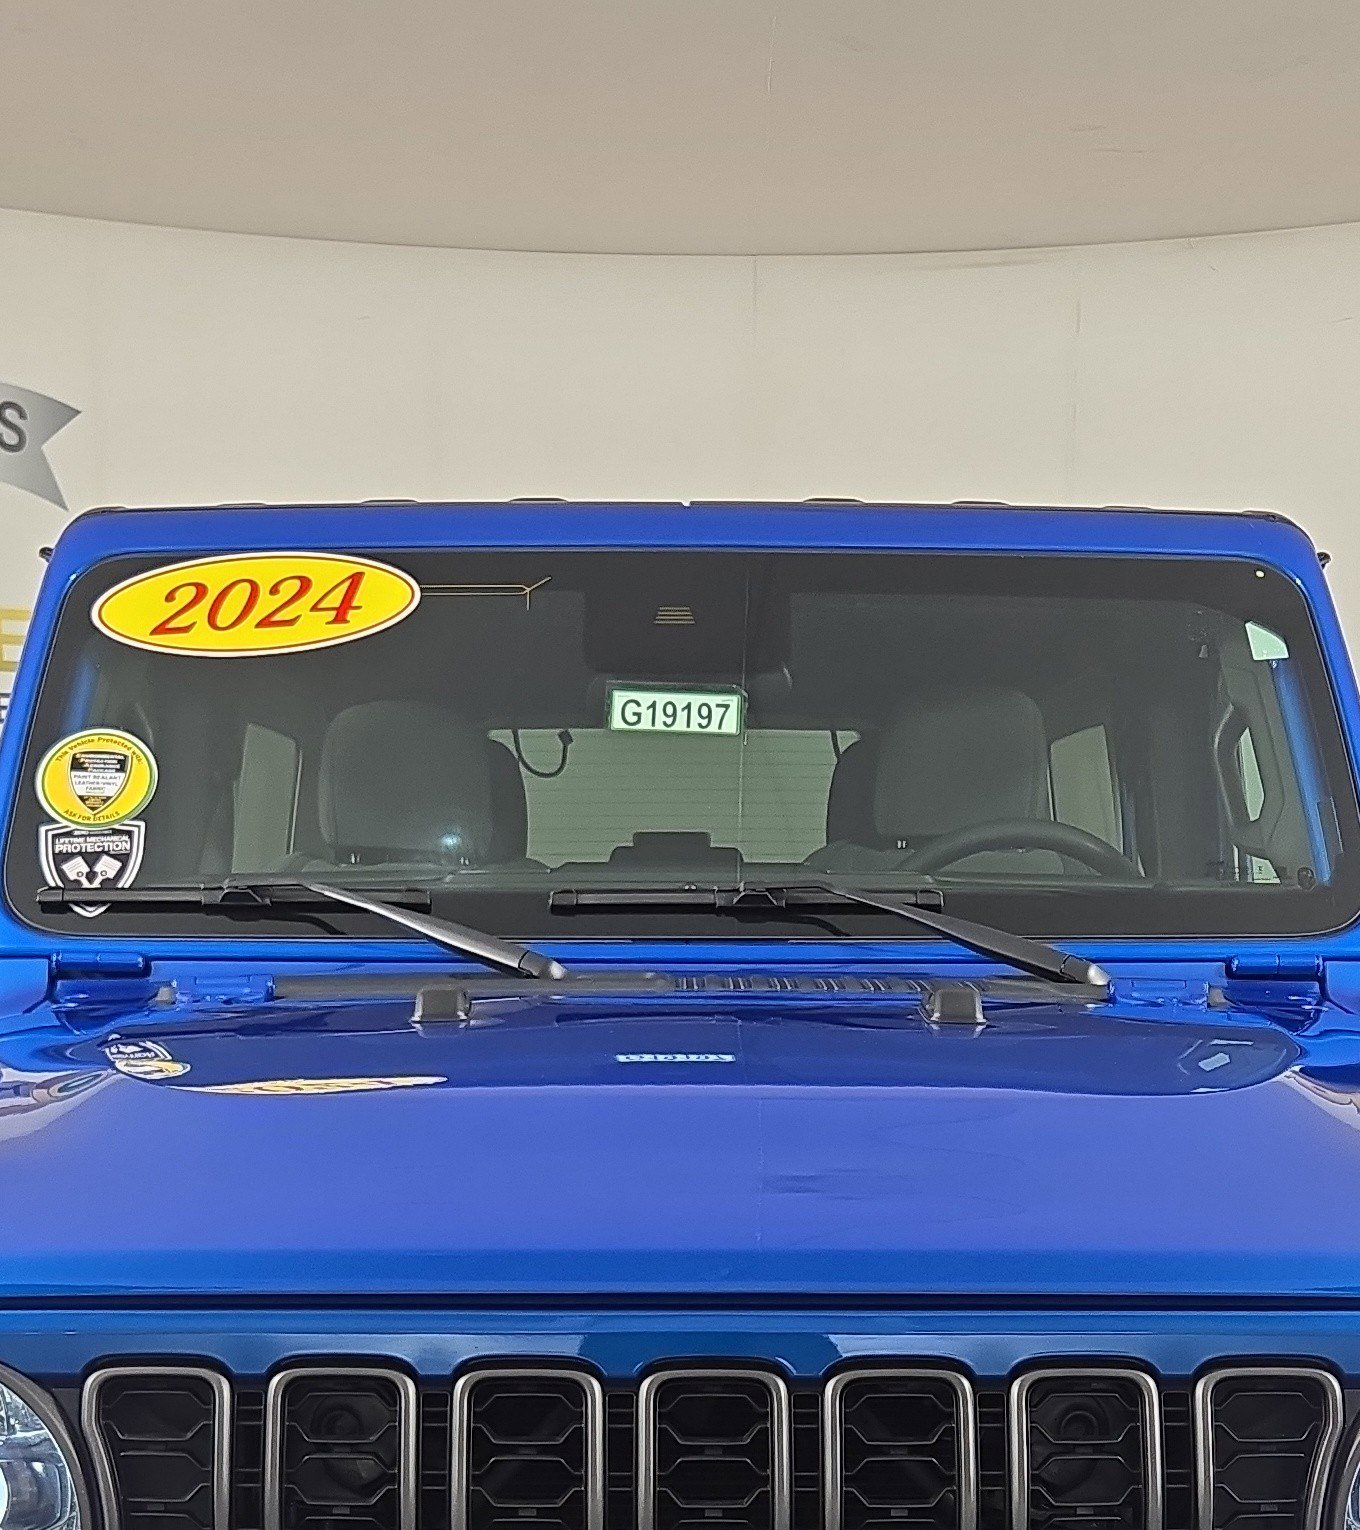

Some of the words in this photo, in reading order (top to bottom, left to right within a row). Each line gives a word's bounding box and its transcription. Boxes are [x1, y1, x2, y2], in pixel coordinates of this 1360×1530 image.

[149, 571, 367, 636] 2024
[620, 698, 731, 731] G19197
[97, 737, 133, 751] Protected
[63, 808, 76, 818] ASK
[77, 813, 91, 821] FOR
[92, 811, 120, 822] DETAILS
[54, 841, 131, 854] PROTECTION
